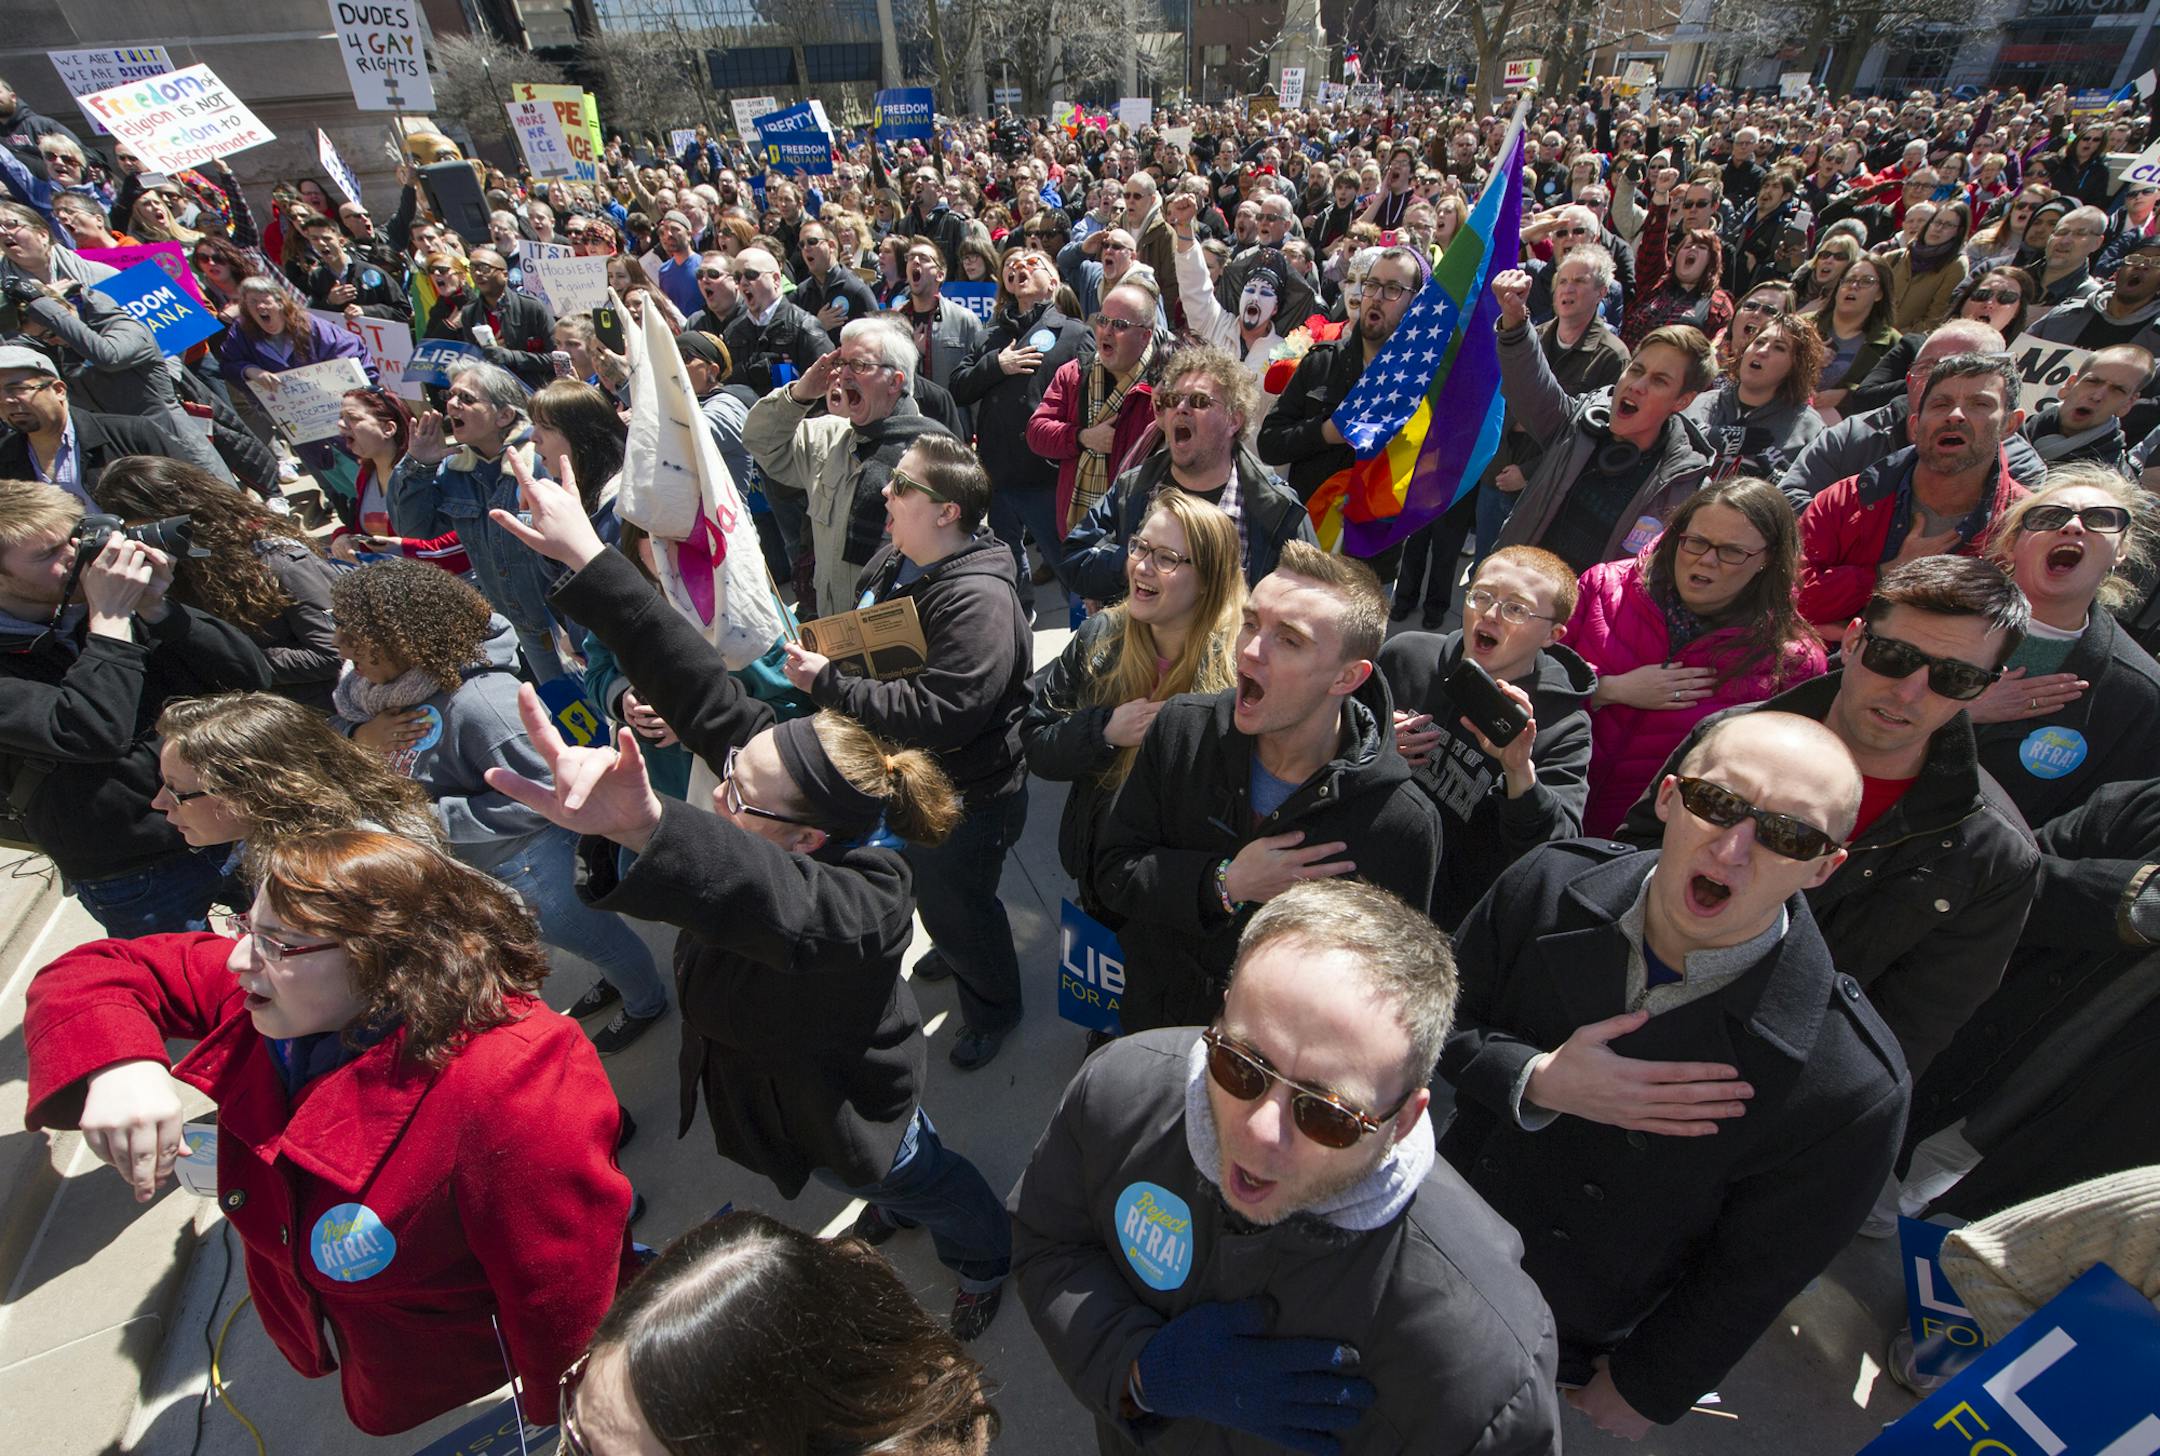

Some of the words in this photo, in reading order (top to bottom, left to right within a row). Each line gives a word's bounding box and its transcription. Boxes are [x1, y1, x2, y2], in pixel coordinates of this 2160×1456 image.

[338, 3, 409, 28] DUDES
[346, 33, 364, 56] 4
[368, 32, 413, 55] GAY
[55, 55, 82, 65] WE
[89, 53, 112, 64] ARE
[356, 56, 418, 76] RIGHTS
[64, 70, 87, 81] WE
[91, 67, 115, 79] ARE
[118, 64, 167, 77] DIVERSE
[89, 75, 206, 119] Freedom
[201, 72, 219, 88] of
[521, 85, 536, 100] I
[112, 110, 177, 139] religion
[199, 91, 230, 112] NOT
[516, 113, 546, 127] MORE
[521, 103, 536, 114] NO
[552, 101, 582, 127] PE
[883, 104, 928, 114] FREEDOM
[884, 115, 930, 126] INDIANA
[135, 119, 221, 157] Freedom
[220, 115, 241, 130] to
[159, 130, 261, 169] Discriminate
[781, 144, 826, 154] FREEDOM
[783, 154, 828, 165] INDIANA
[1300, 142, 1322, 159] ERTY
[146, 303, 193, 333] ANA
[2029, 741, 2078, 768] RFRA!
[1063, 928, 1126, 995] LIB
[1062, 974, 1101, 1007] FOR
[1107, 998, 1119, 1010] A
[1136, 1191, 1188, 1233] Reject
[321, 1231, 384, 1269] RFRA!
[1124, 1205, 1186, 1272] RFRA!
